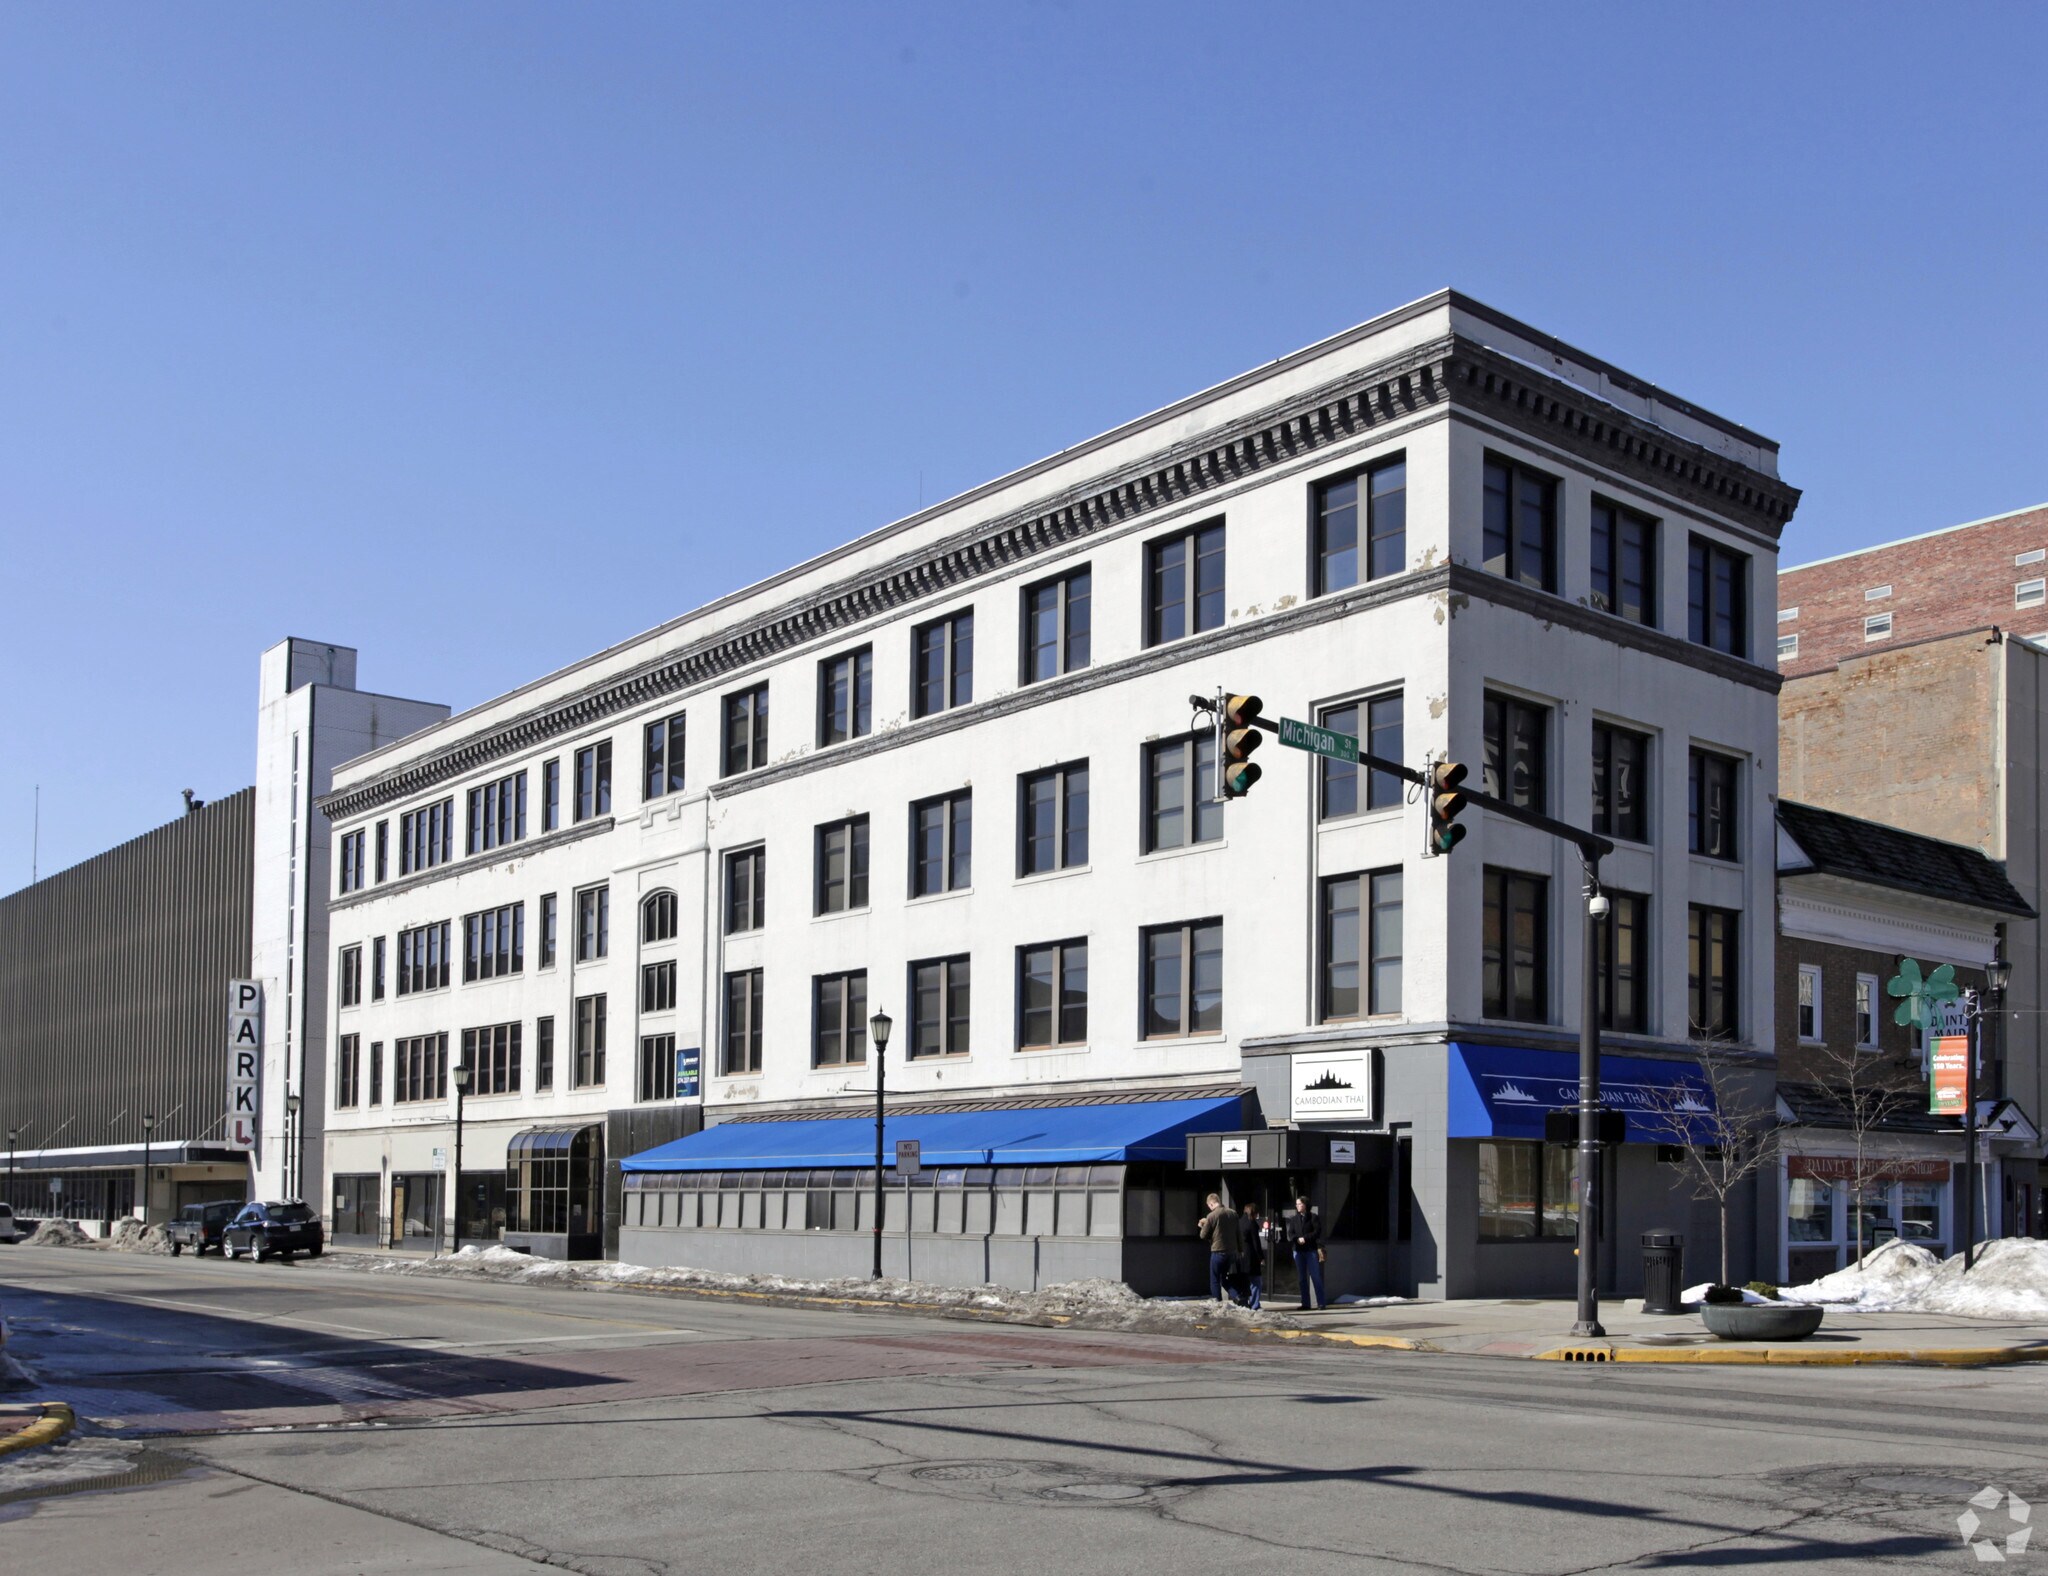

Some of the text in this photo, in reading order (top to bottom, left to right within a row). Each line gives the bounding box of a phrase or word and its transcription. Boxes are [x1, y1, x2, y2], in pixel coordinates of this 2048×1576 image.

[1283, 720, 1352, 752] Michigan St
[236, 984, 256, 1112] PARK
[1932, 1054, 1965, 1062] Celebrating
[677, 1069, 698, 1077] AVAILABLE
[1294, 1095, 1364, 1106] CAMBODIAN THAI
[1559, 1087, 1625, 1103] CAMDIAN
[903, 1143, 913, 1151] NO
[1807, 1159, 1848, 1174] DAINTY
